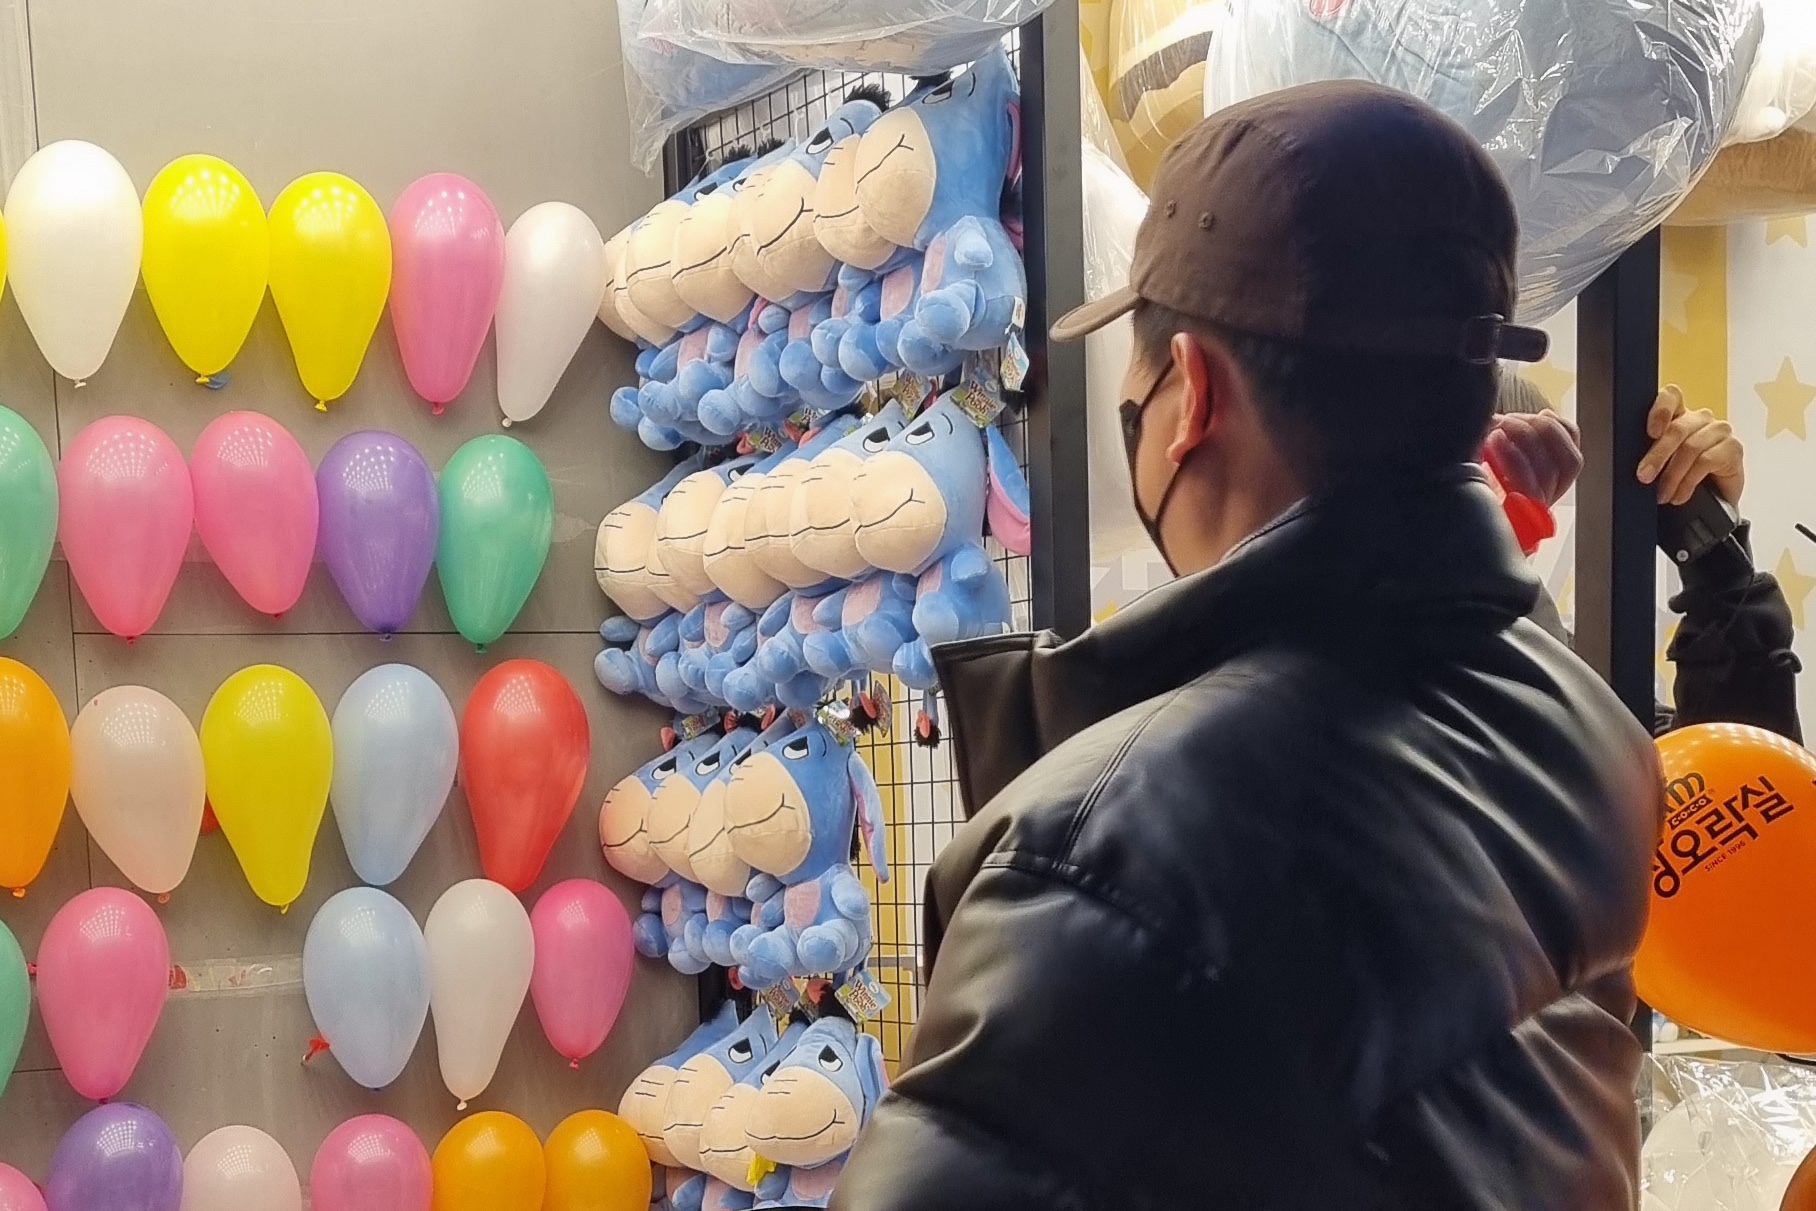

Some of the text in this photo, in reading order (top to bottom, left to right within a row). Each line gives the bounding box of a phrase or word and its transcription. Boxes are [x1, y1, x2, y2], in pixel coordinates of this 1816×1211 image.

[965, 392, 987, 414] Pooh
[970, 381, 997, 411] Winnie
[849, 989, 867, 1012] Pooh
[856, 979, 877, 1009] Winnie
